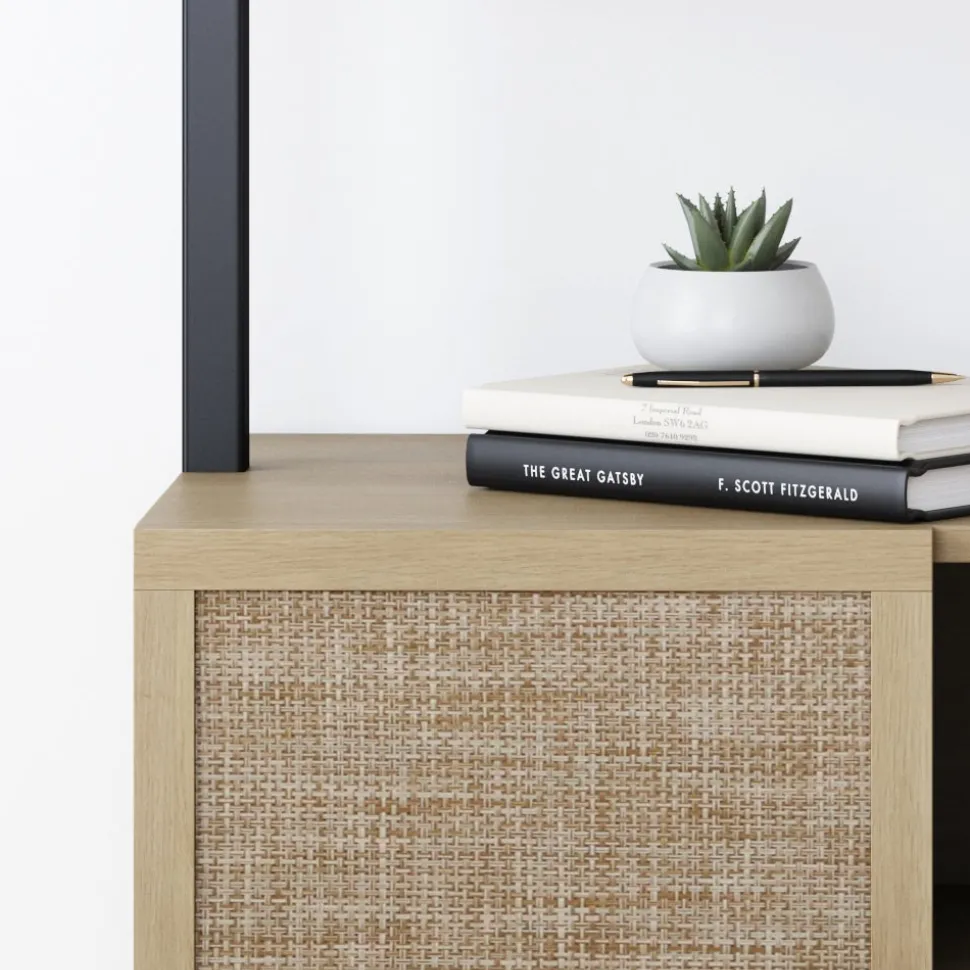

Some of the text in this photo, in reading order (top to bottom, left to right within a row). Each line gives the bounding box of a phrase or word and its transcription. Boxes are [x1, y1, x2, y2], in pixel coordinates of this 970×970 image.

[523, 464, 644, 486] THE GREAT GATSBY
[718, 477, 859, 502] F. SCOTT FITZGERALD
